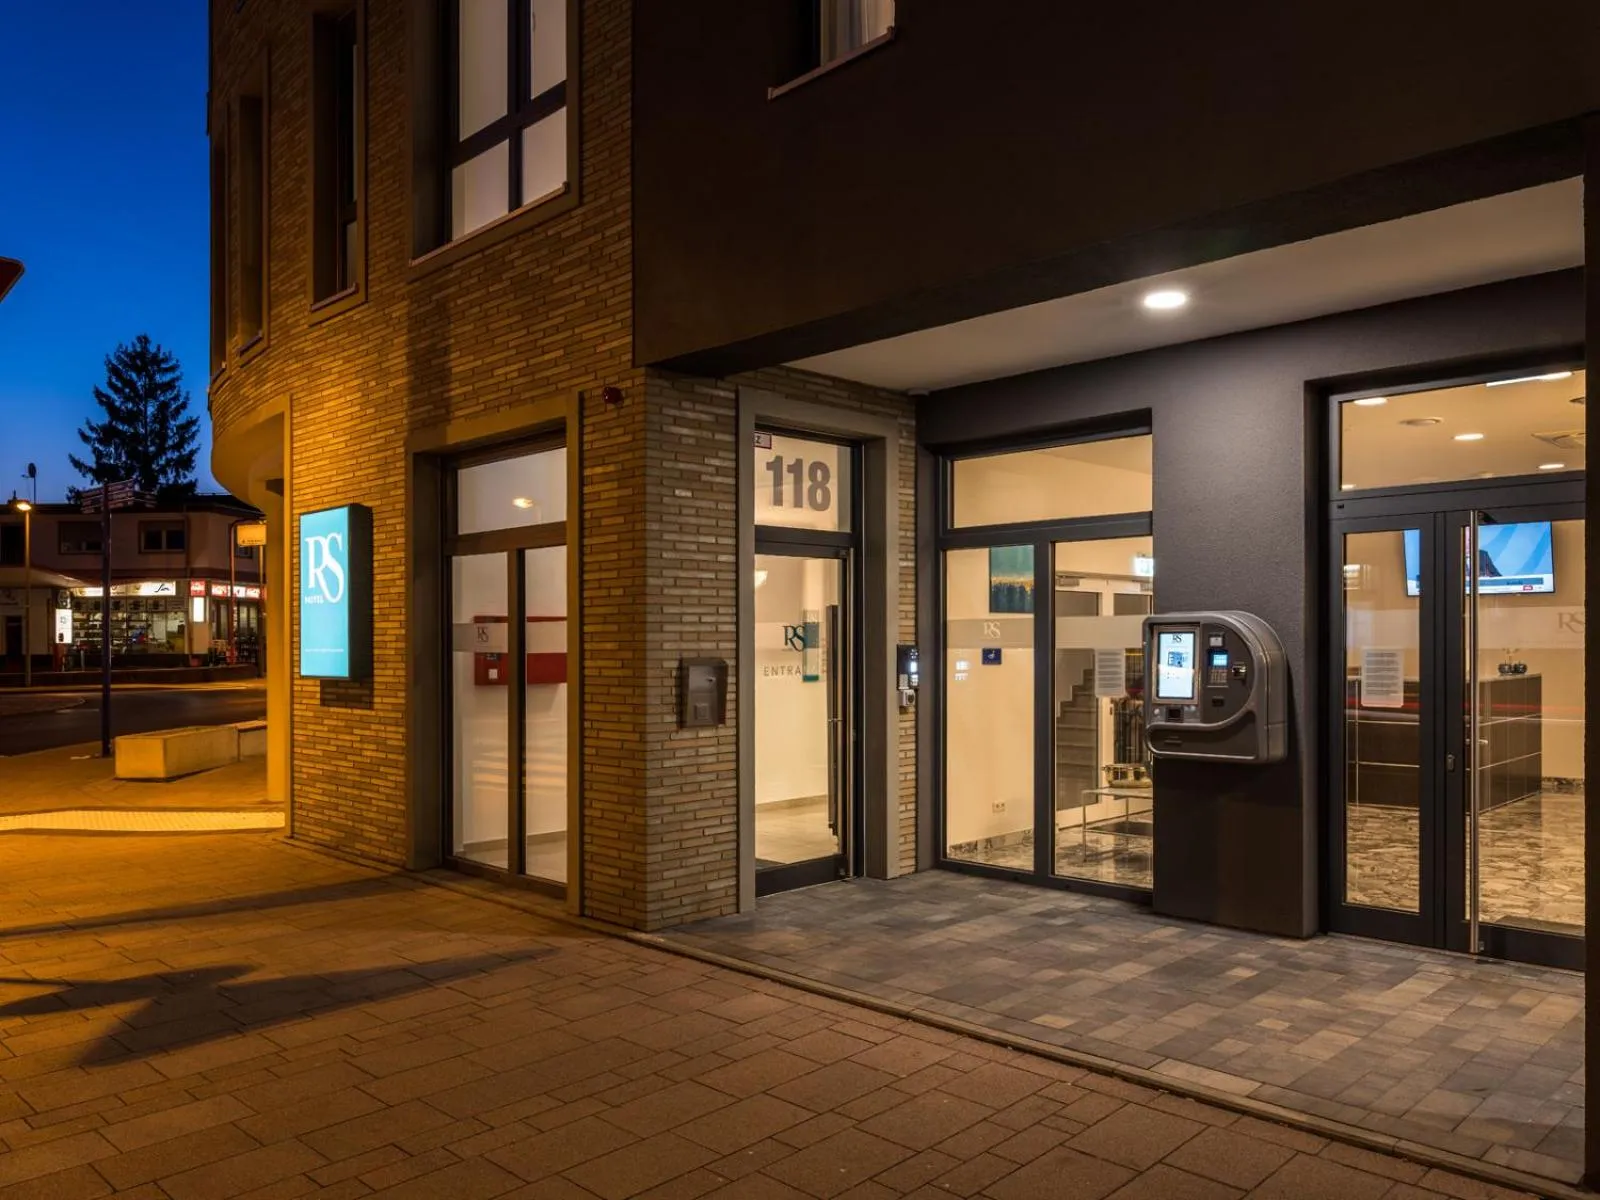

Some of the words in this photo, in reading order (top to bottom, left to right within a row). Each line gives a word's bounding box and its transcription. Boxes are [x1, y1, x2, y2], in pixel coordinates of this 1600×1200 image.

[766, 455, 831, 511] 118
[304, 532, 345, 604] RS
[983, 621, 1001, 639] RS
[1556, 612, 1585, 634] RS
[782, 625, 806, 652] RS
[763, 665, 802, 677] ENTRA
